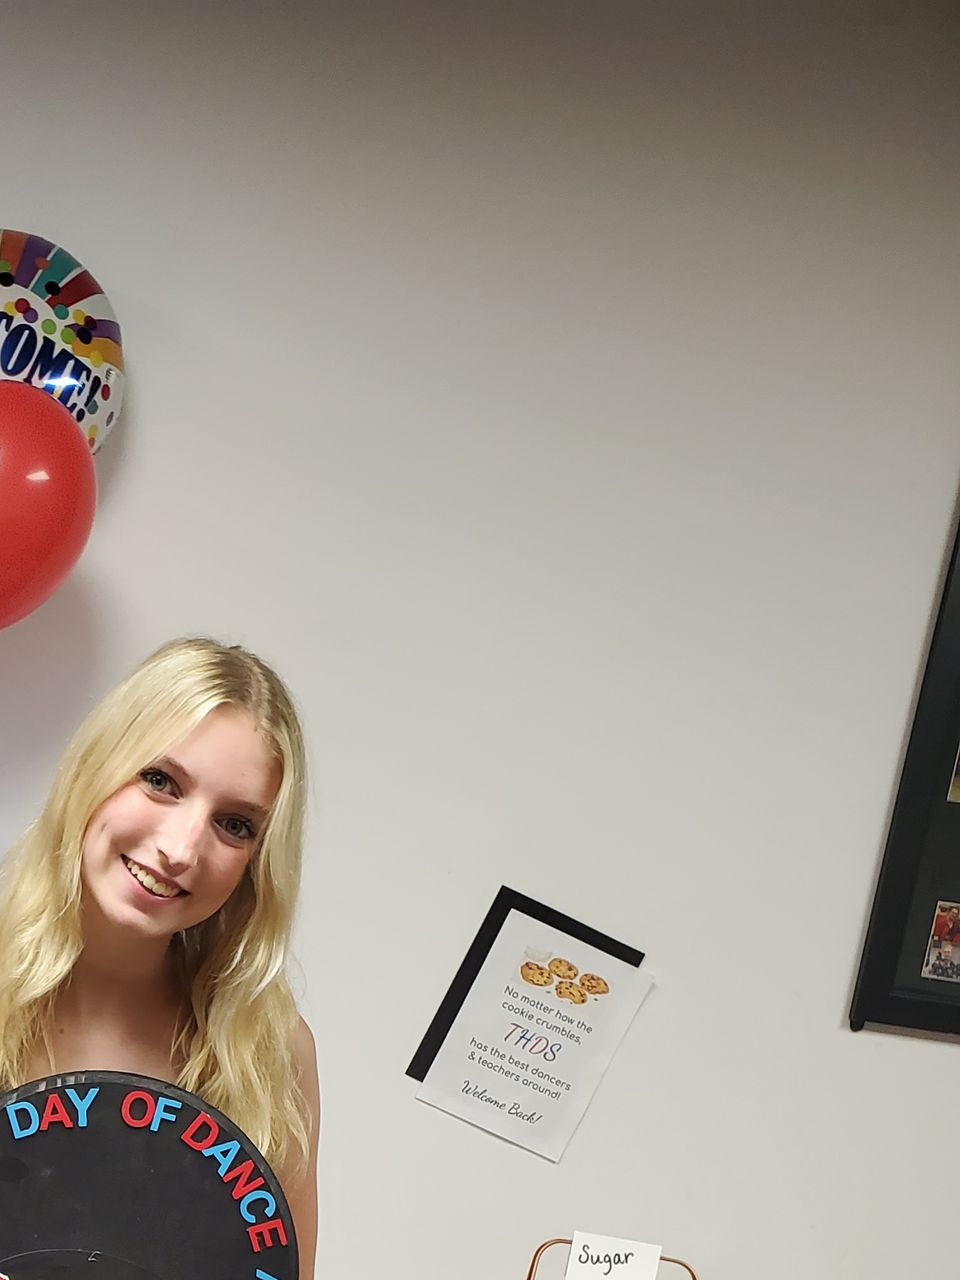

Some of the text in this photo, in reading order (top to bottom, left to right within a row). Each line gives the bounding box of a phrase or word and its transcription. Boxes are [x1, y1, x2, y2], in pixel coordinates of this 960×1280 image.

[502, 1001, 582, 1045] cookie crumbles,
[504, 985, 593, 1034] No matter how the
[470, 1037, 571, 1091] has the best dancers
[504, 1022, 562, 1062] THDS
[468, 1051, 562, 1101] & teachers around!
[461, 1080, 543, 1124] Welcome Back!
[5, 1086, 100, 1140] DAY
[120, 1090, 183, 1133] OF
[181, 1112, 289, 1253] DANCE
[578, 1244, 634, 1276] Sugar
